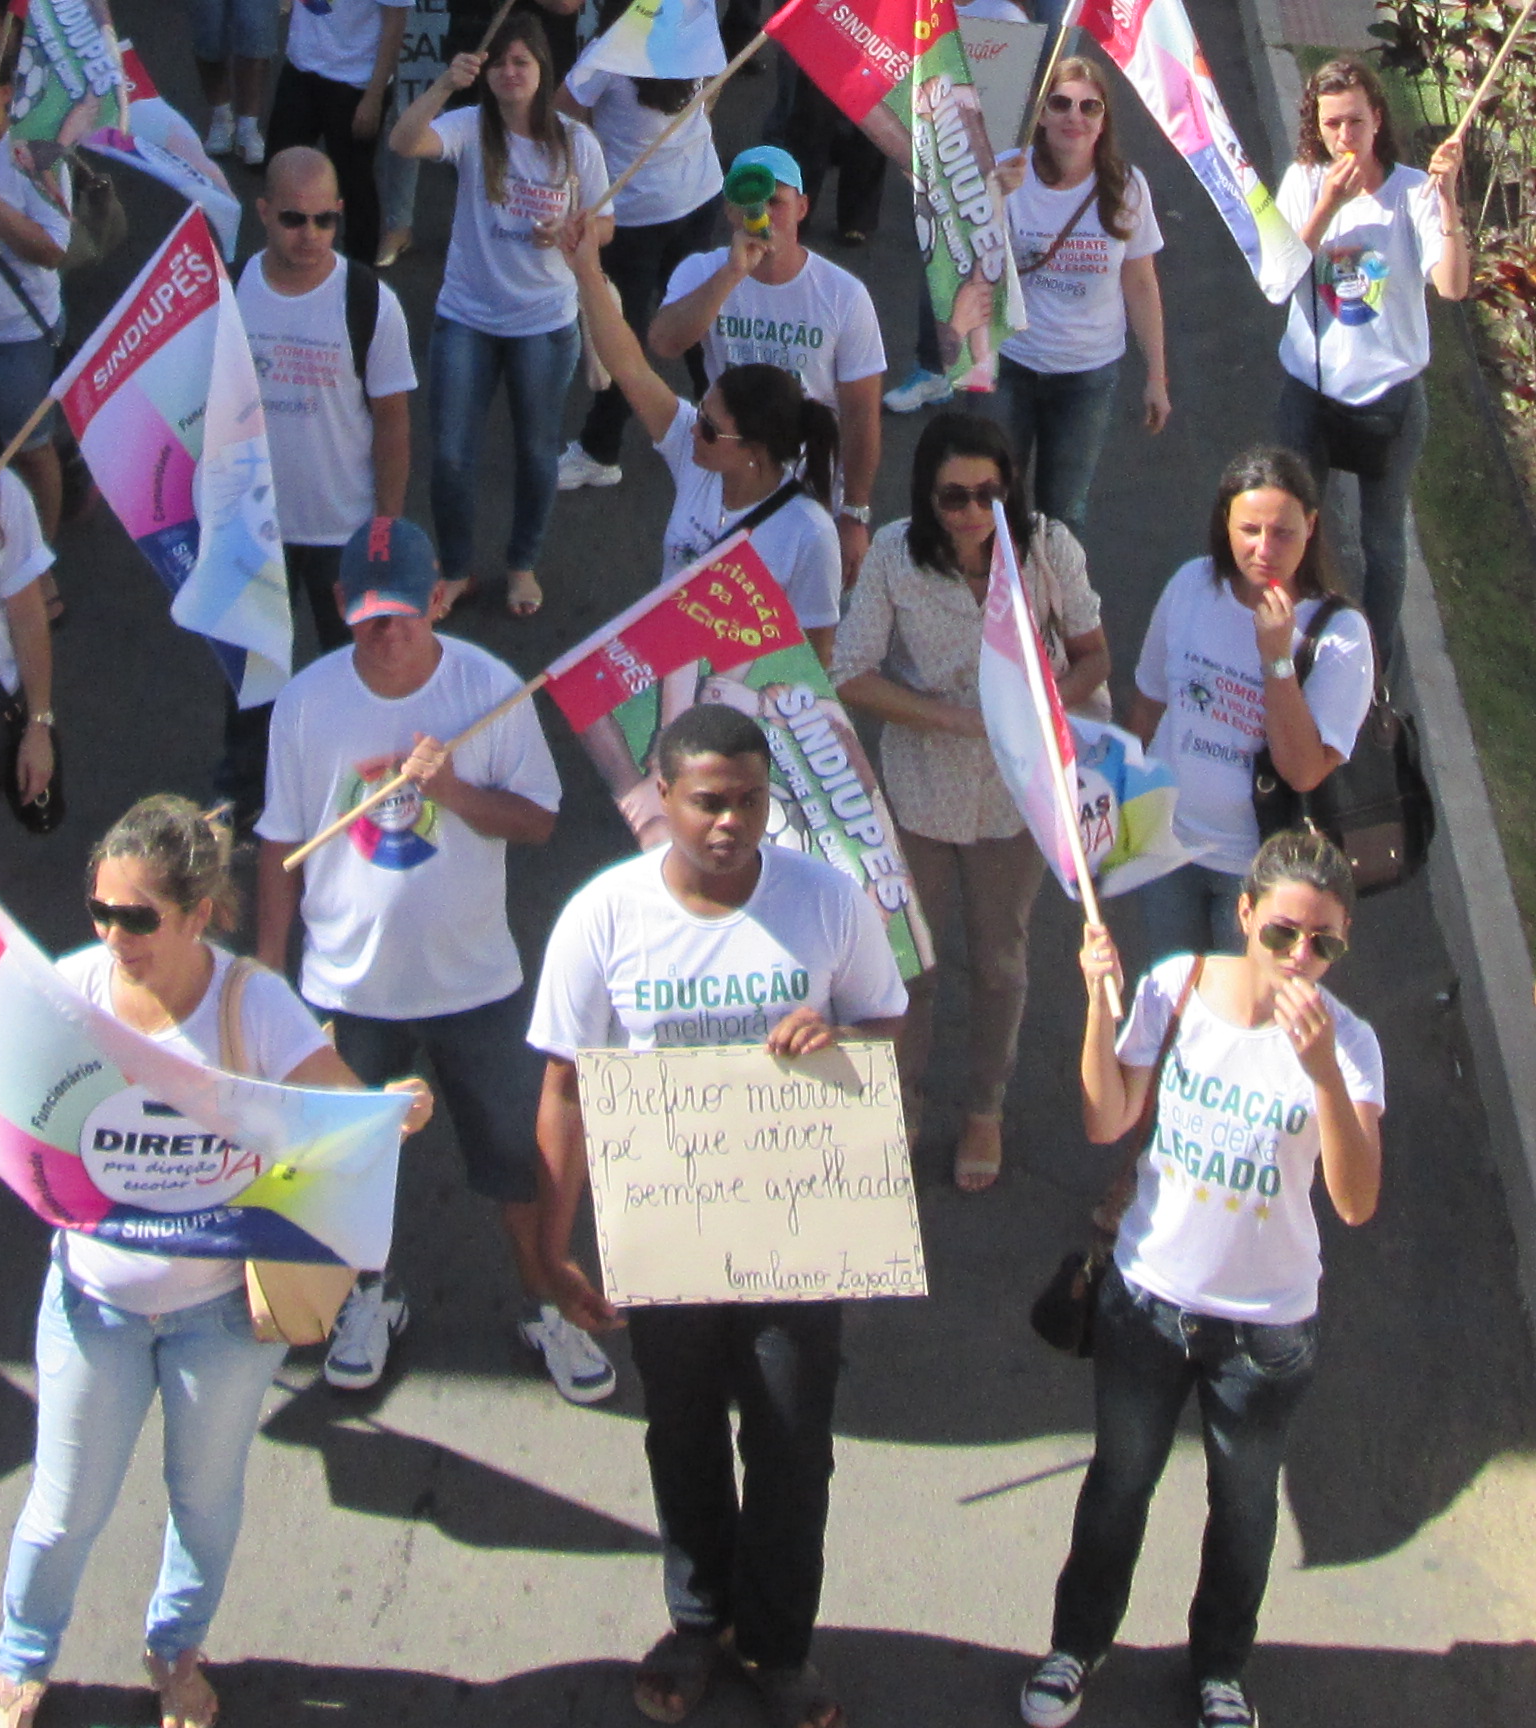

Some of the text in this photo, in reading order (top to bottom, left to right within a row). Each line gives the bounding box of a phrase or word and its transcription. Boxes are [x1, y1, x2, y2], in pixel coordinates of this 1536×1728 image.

[831, 3, 911, 82] SINDIUPES
[931, 75, 1005, 282] SINDIUPES
[91, 251, 213, 392] SINDIUPES
[714, 314, 824, 349] EDUCAÇÃO
[1215, 676, 1266, 707] COMBA
[766, 727, 810, 796] SEMPRE
[777, 687, 908, 911] SINDIUPES
[634, 963, 810, 1013] EDUCAÇÃO
[654, 1009, 769, 1041] melhora
[31, 1058, 103, 1131] Funcionários
[747, 1080, 851, 1114] morrer
[858, 1054, 890, 1109] de
[92, 1127, 236, 1158] DIRETA
[599, 1120, 845, 1192] pé que viver
[1156, 1123, 1282, 1198] LEGADO
[1170, 1107, 1204, 1136] que
[1210, 1116, 1279, 1163] deixa
[102, 1158, 218, 1180] pra direção
[123, 1178, 191, 1194] escolar
[122, 1204, 245, 1241] SINDIUPES
[624, 1172, 750, 1236] sempre
